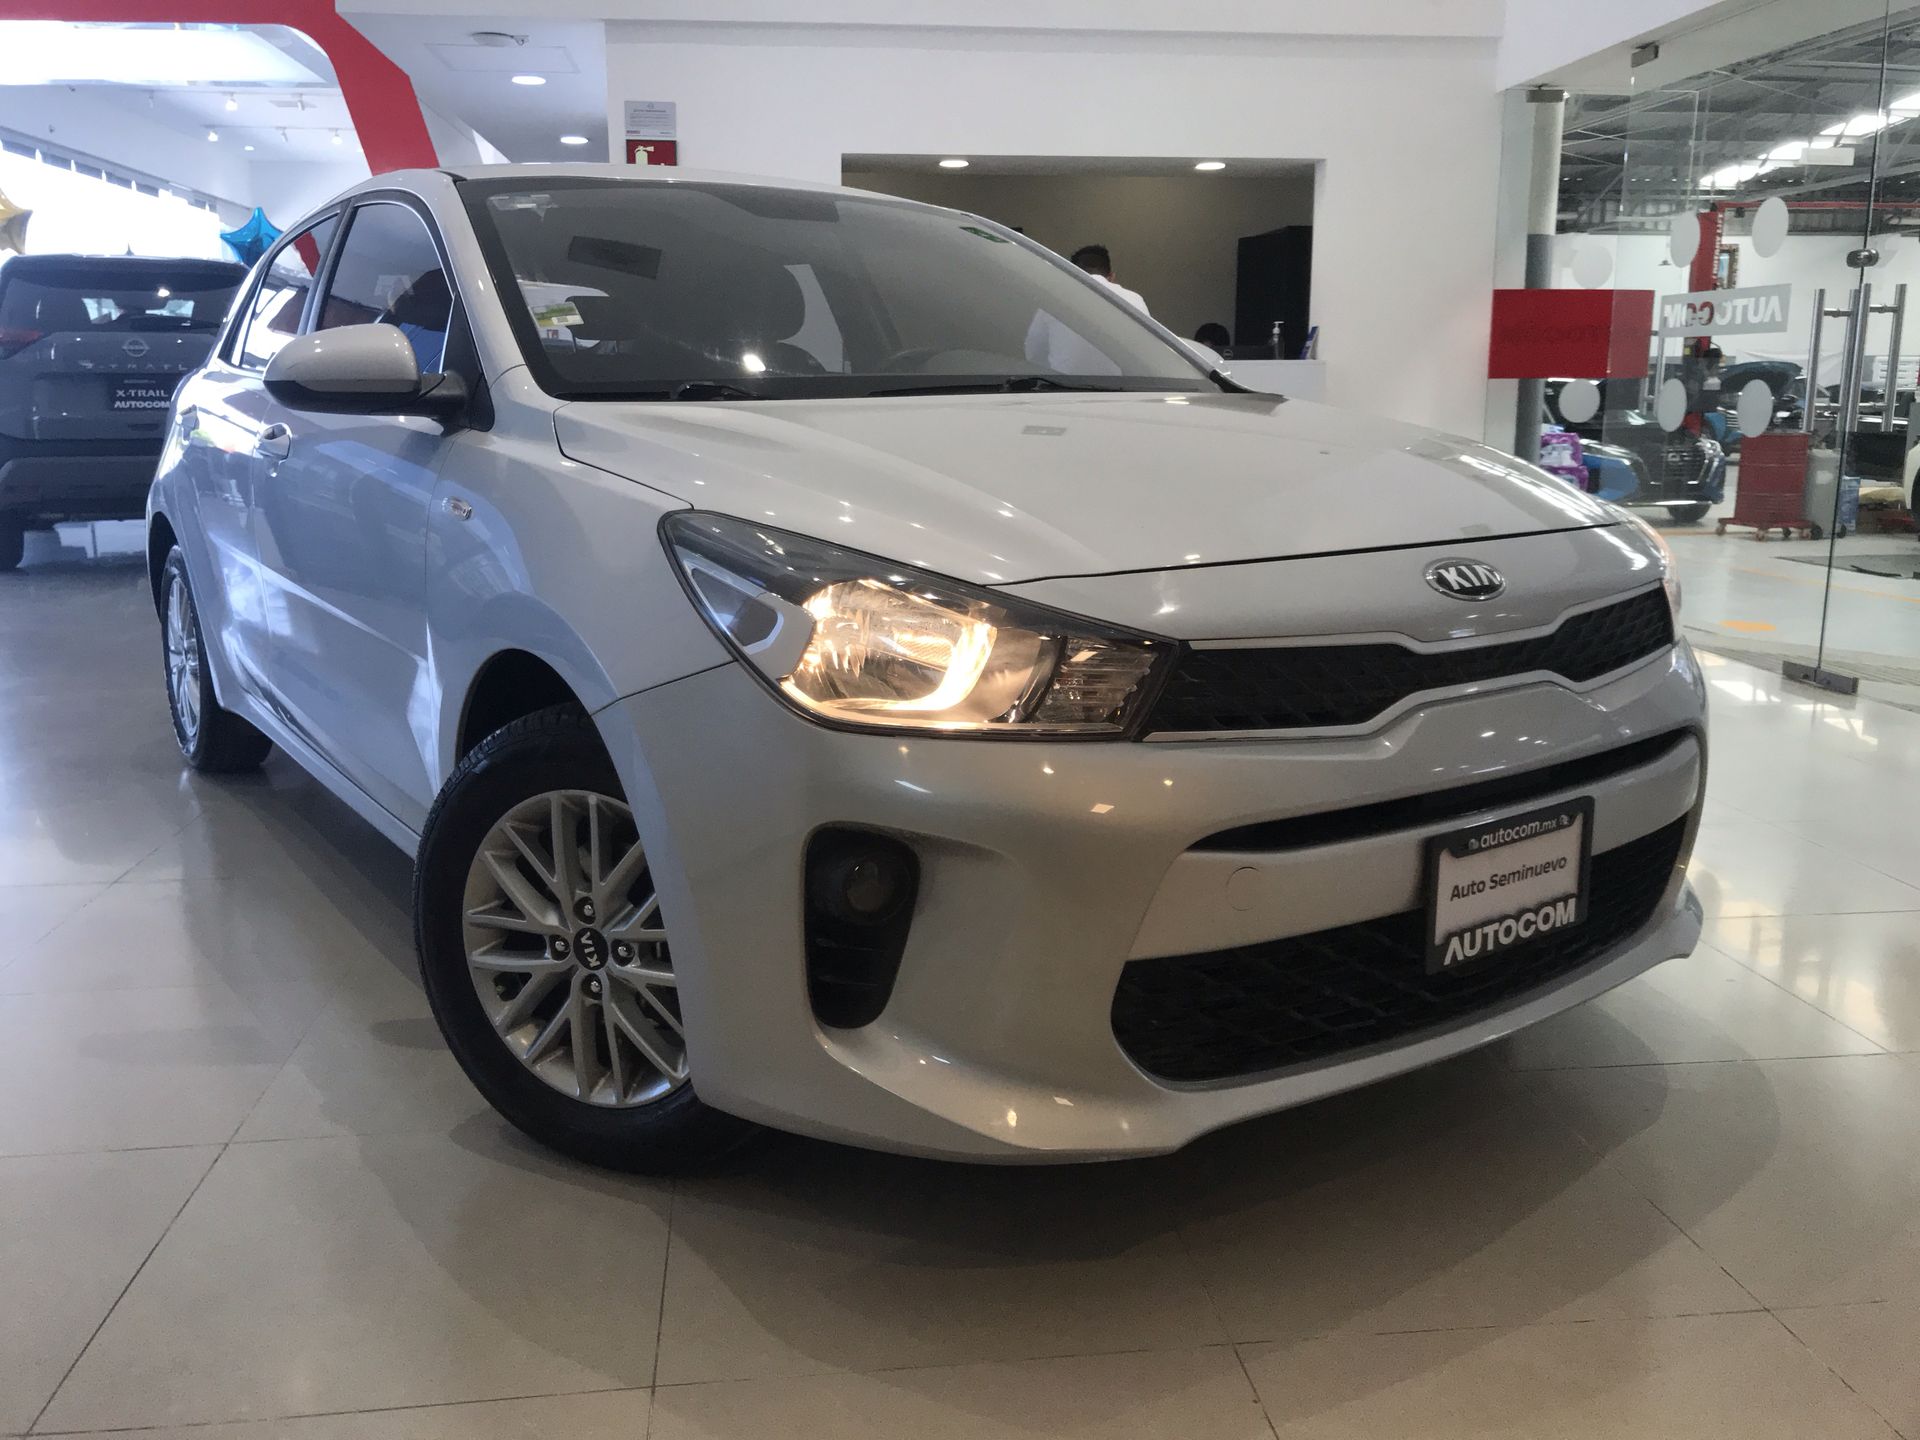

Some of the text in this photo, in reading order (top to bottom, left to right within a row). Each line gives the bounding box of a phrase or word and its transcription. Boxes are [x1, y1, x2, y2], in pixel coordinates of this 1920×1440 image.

[114, 401, 170, 409] AUTOCOM
[1438, 565, 1500, 590] KIA
[1481, 817, 1557, 847] autocom.mx
[1450, 856, 1567, 901] Auto Seminuevo
[1444, 898, 1576, 966] AUTOCOM
[581, 931, 601, 968] KIA
